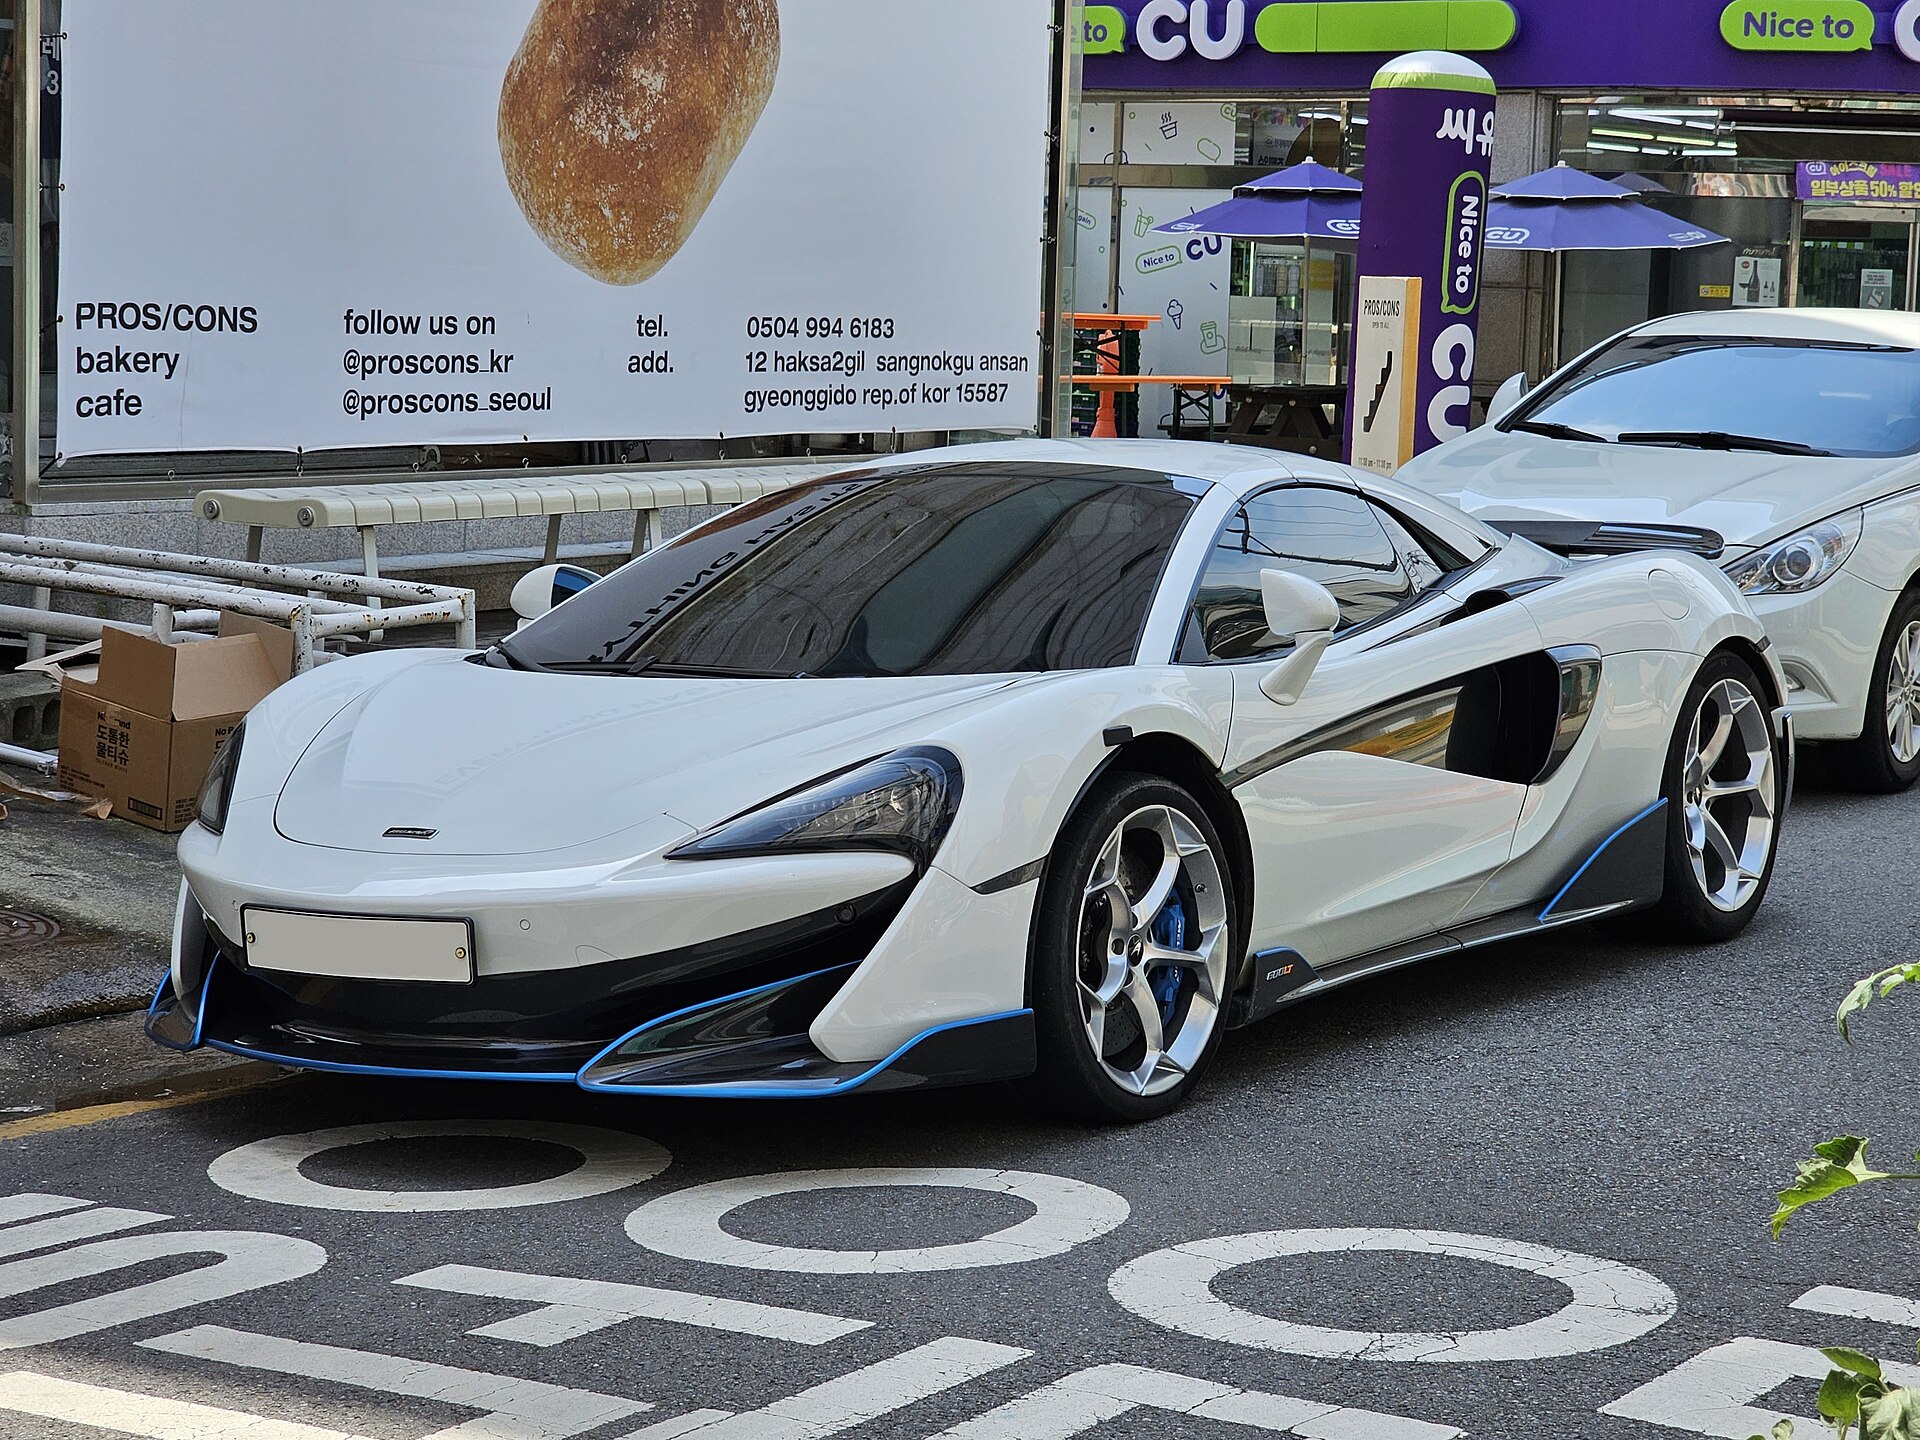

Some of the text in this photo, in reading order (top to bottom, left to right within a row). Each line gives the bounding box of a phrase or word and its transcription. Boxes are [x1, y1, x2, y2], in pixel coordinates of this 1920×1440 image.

[1083, 20, 1108, 42] to
[1136, 0, 1245, 61] CU
[1743, 11, 1855, 39] Nice to
[1808, 164, 1823, 172] CU
[1810, 180, 1868, 197] 일부상품
[1869, 181, 1897, 198] 50%
[1186, 236, 1222, 260] CU
[1455, 195, 1479, 293] Nice to
[1143, 253, 1175, 268] Nice to
[76, 303, 258, 333] PROS/CONS
[1363, 300, 1400, 317] PROS/CONS
[344, 309, 496, 335] follow us on
[637, 314, 668, 337] tel.
[747, 316, 895, 339] 0504 994 6183
[77, 346, 180, 380] bakery
[343, 349, 514, 381] @proscons_kr
[628, 350, 674, 373] add.
[746, 350, 1028, 376] 12 haksa2gil sangnokgu ansan
[1427, 323, 1475, 443] CU
[76, 388, 142, 418] cafe
[343, 386, 551, 420] @proscons_seoul
[744, 383, 1008, 413] gyeonggido rep.of kor 15587
[97, 741, 129, 766] 물티슈
